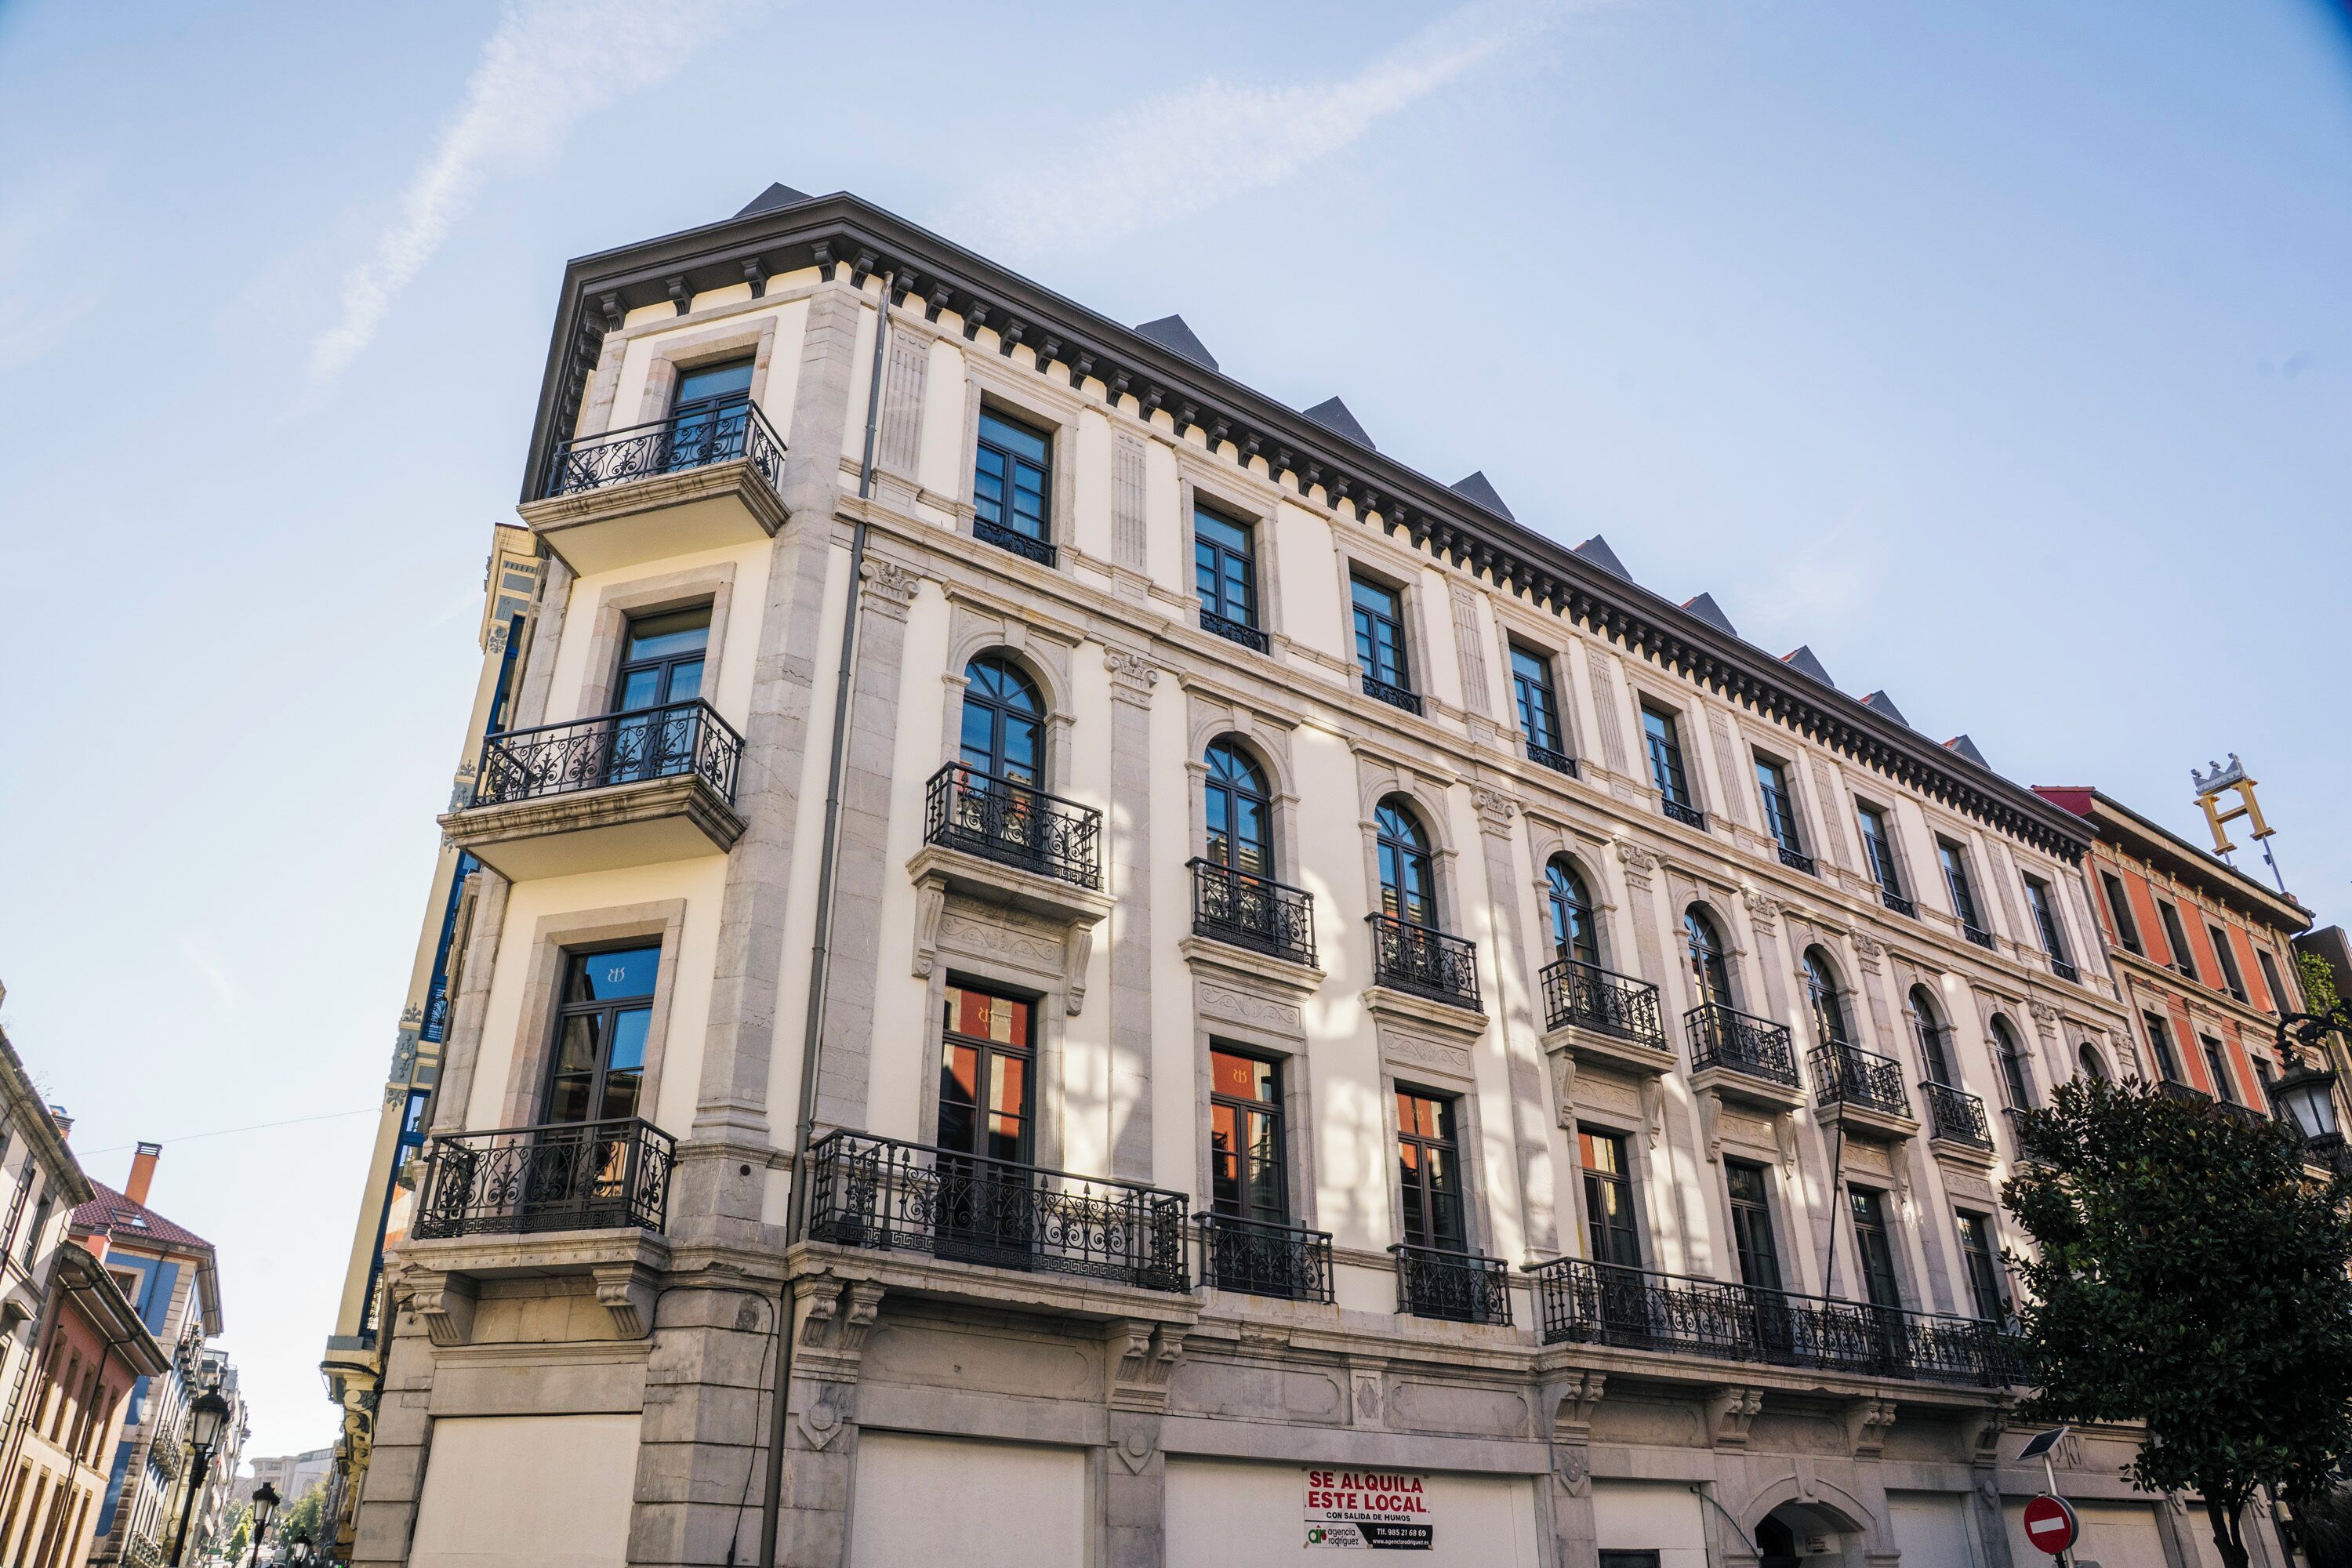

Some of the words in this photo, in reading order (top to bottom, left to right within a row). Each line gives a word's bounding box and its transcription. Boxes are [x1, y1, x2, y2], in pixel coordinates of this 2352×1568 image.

[2193, 779, 2277, 856] H
[1309, 1471, 1334, 1488] SE
[1341, 1472, 1423, 1493] ALQUILA
[1308, 1491, 1357, 1509] ESTE
[1364, 1494, 1426, 1512] LOCAL
[1327, 1528, 1356, 1537] agencia
